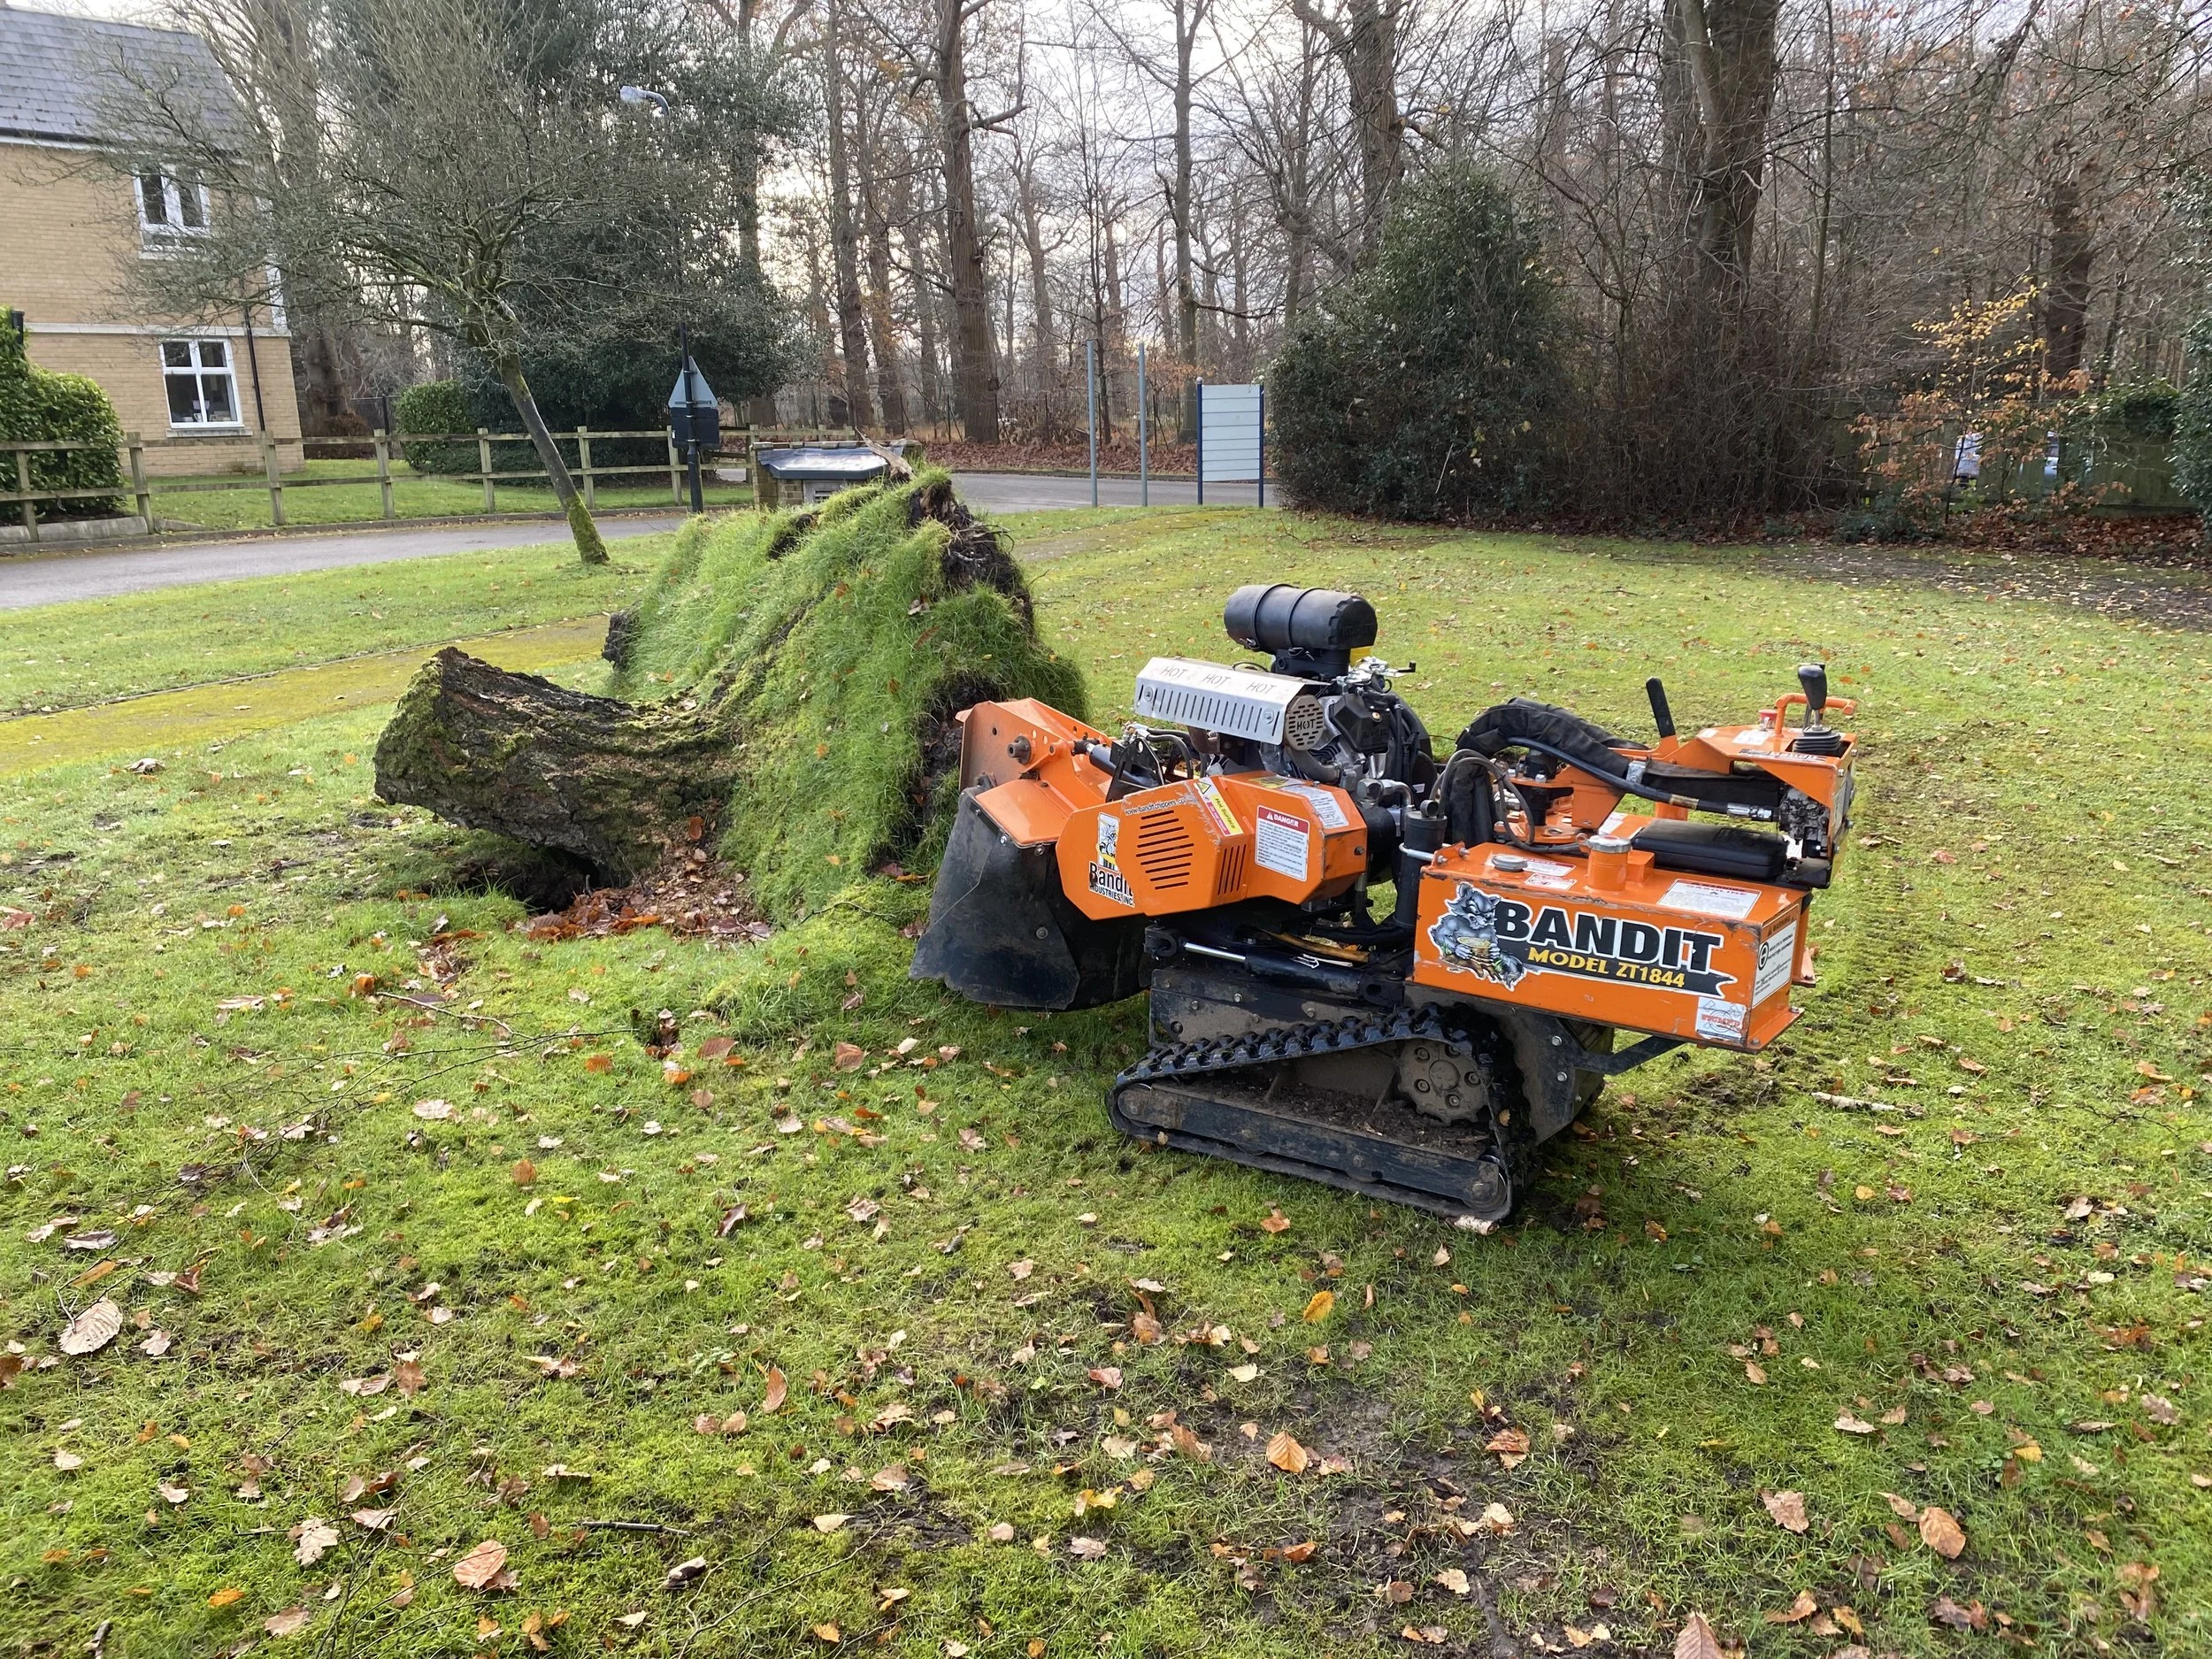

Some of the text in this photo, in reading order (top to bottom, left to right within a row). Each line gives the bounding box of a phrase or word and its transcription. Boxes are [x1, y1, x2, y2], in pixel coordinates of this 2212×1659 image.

[1162, 666, 1277, 694] HOT HOT HOT
[1296, 718, 1316, 730] HOT
[1274, 814, 1299, 827] DANGER
[1090, 884, 1122, 902] DUSTRIES,
[1495, 902, 1722, 972] BANDIT
[1528, 947, 1685, 987] MODEL ZT1844
